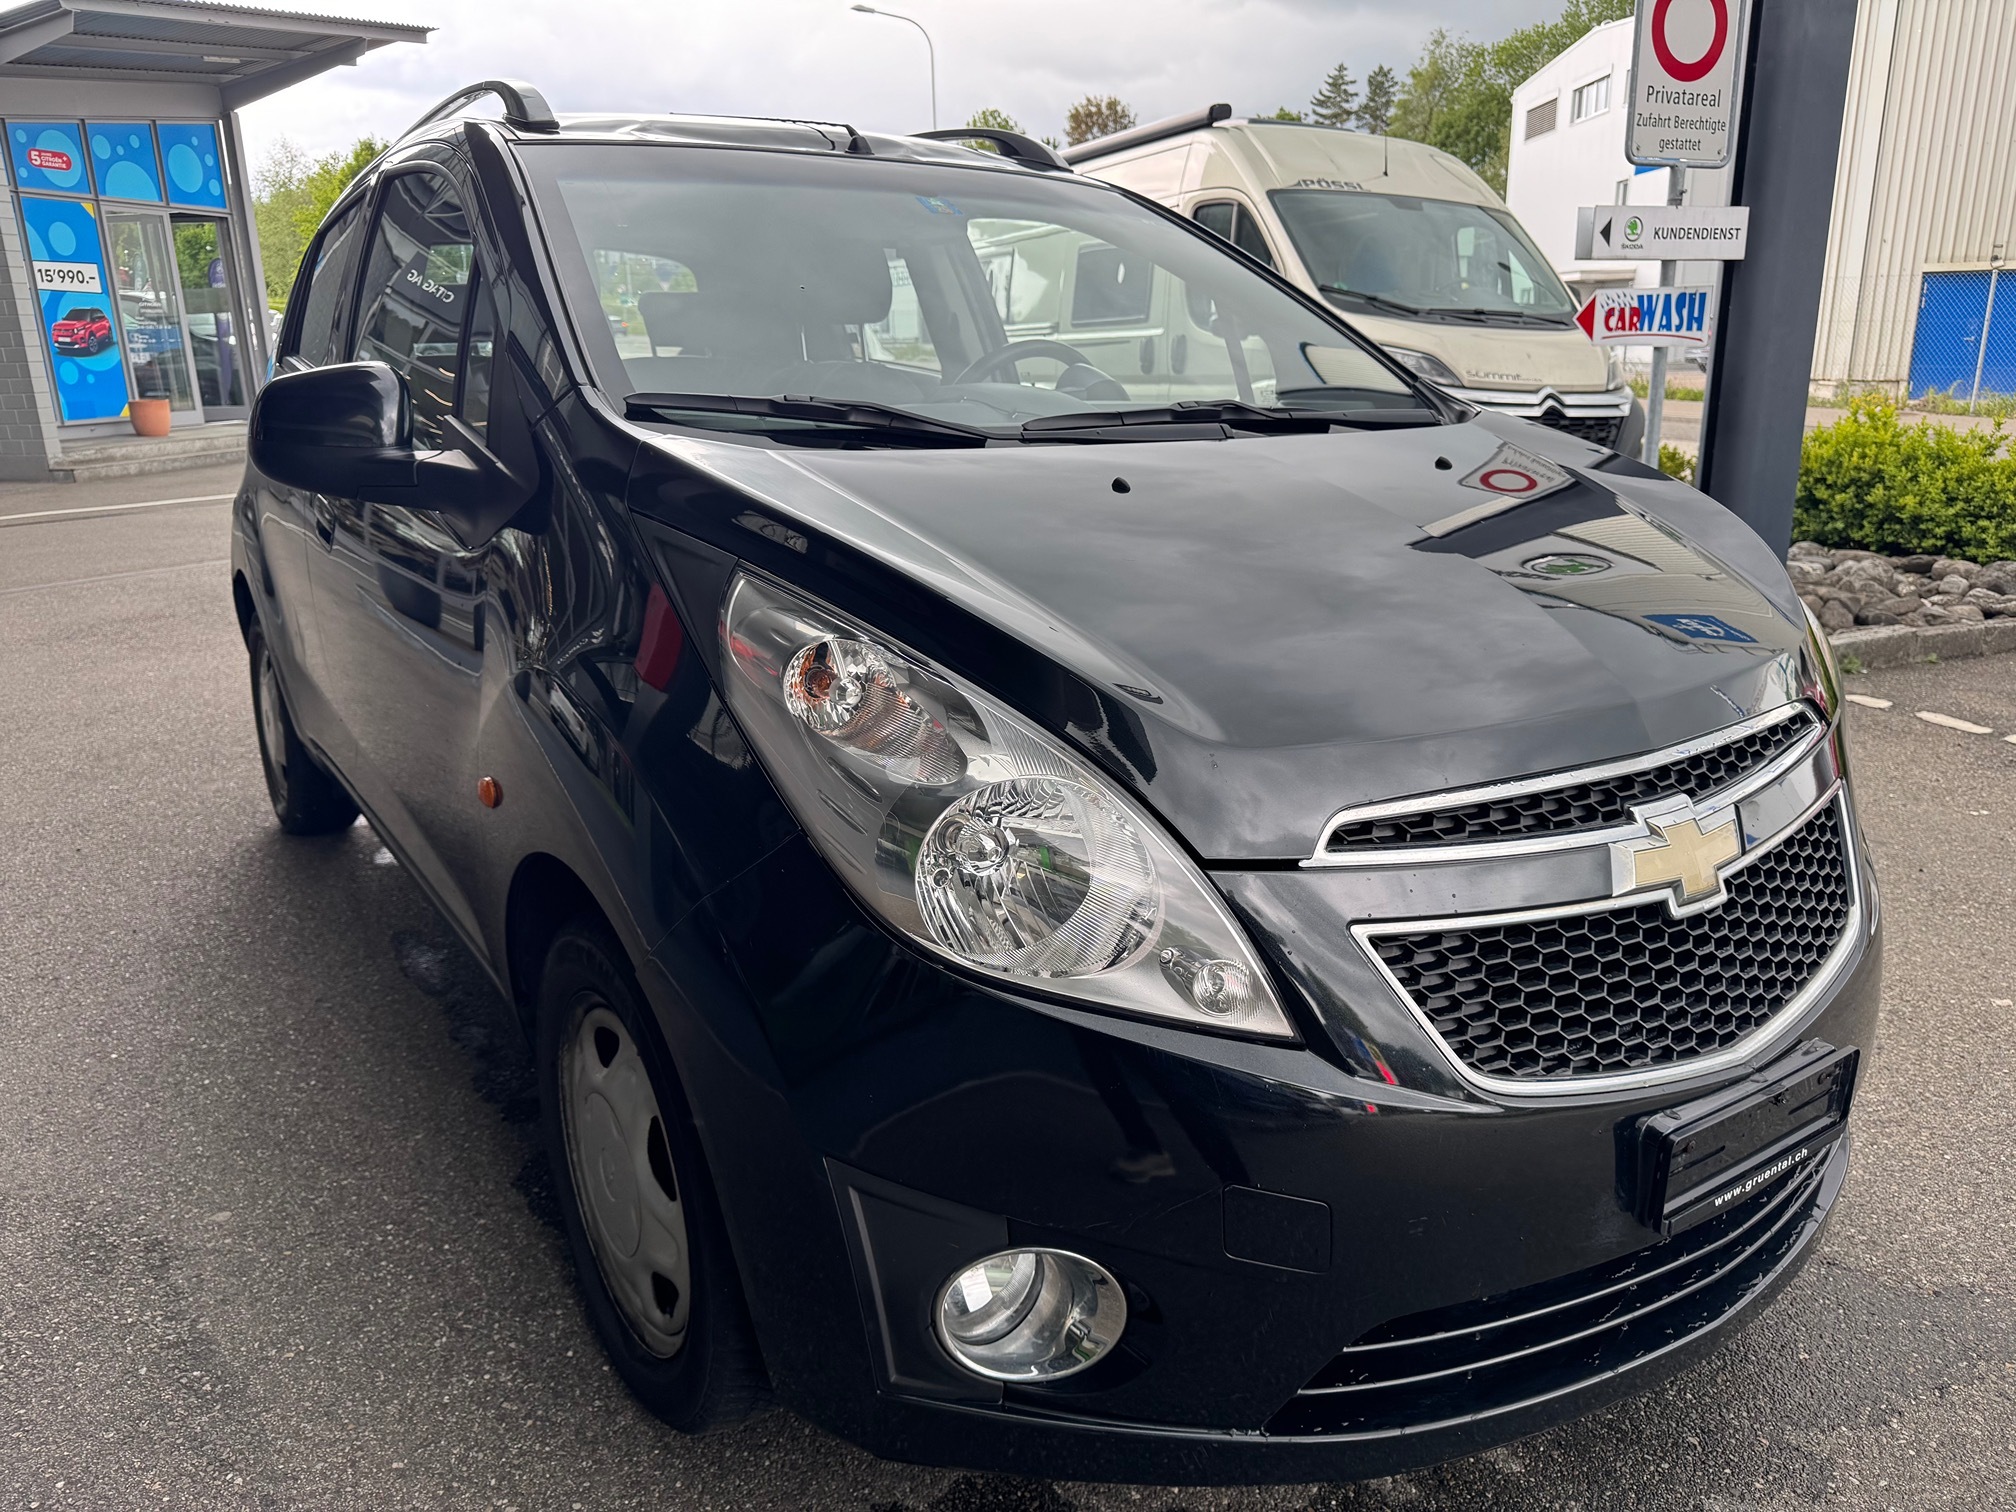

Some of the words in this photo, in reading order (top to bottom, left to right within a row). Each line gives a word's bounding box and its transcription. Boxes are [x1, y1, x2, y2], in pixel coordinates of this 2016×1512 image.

[1646, 85, 1721, 107] Privatareal
[1636, 112, 1671, 128] Zufahrt
[1674, 115, 1726, 135] Berechtigte
[1658, 138, 1702, 153] gestattet
[30, 150, 41, 166] 5
[1653, 226, 1741, 240] KUNDENDIENST
[37, 268, 96, 284] 15'990.-
[1714, 1148, 1808, 1207] www.gruental.ch
